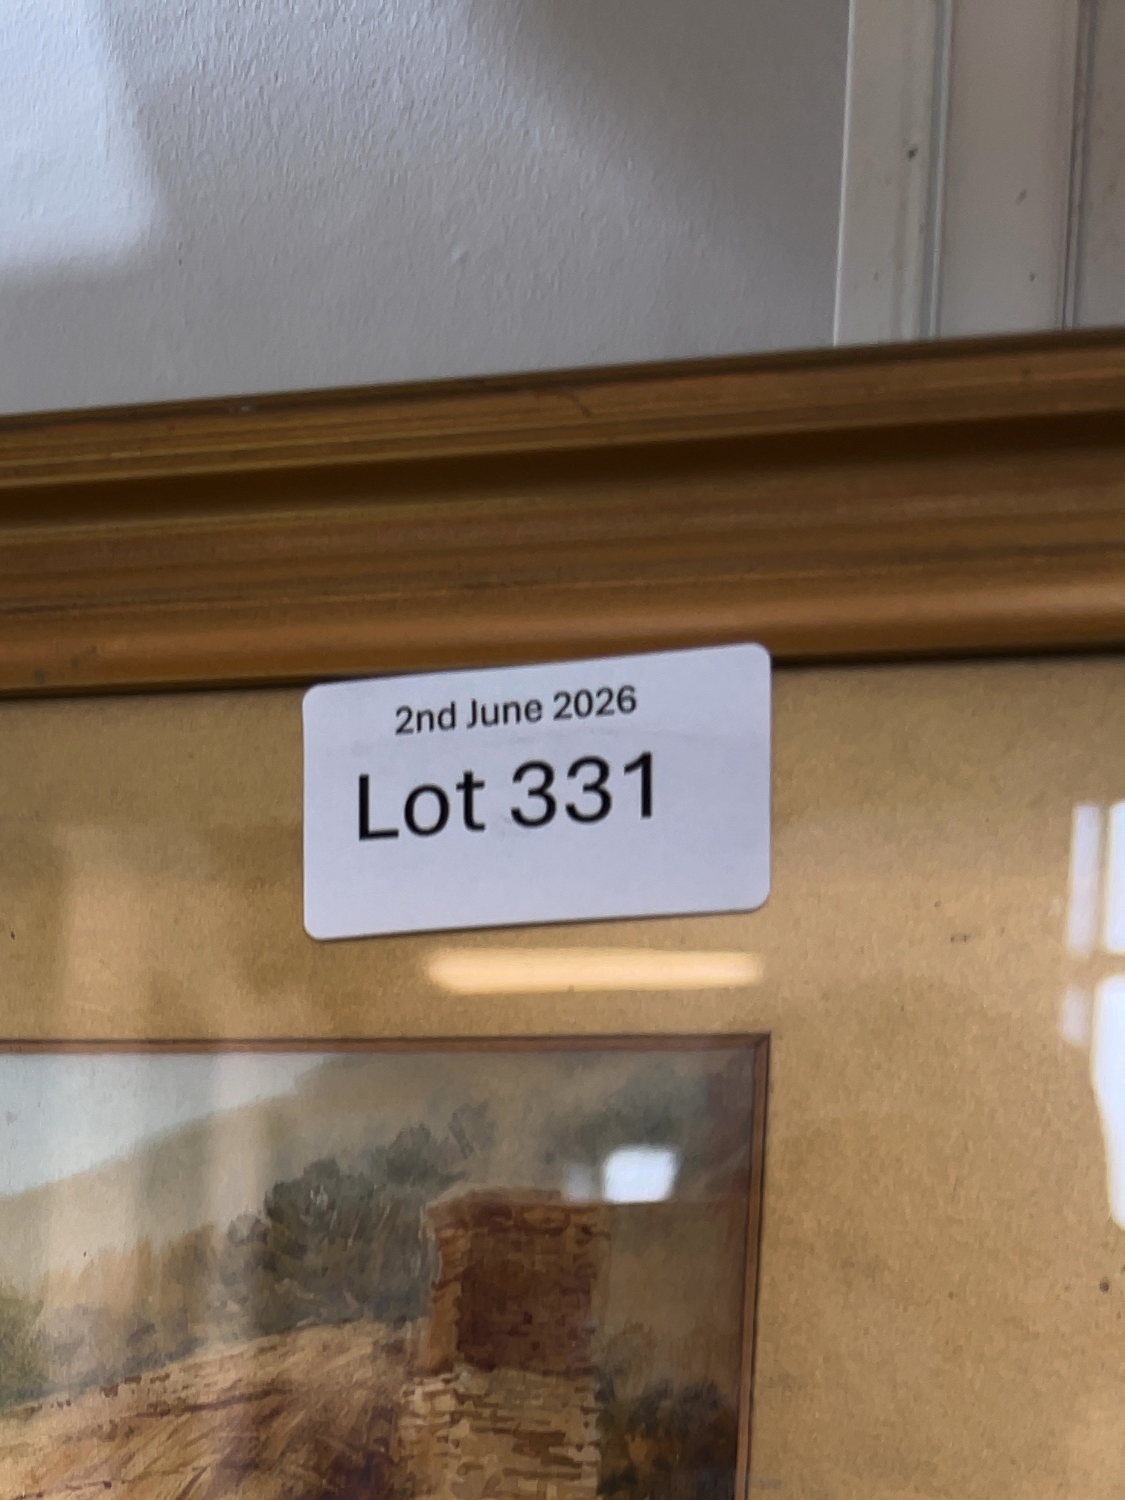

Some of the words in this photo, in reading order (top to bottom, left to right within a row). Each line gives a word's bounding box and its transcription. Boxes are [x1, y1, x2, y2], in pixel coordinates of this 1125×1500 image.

[395, 701, 457, 735] 2nd
[466, 697, 543, 730] June
[553, 685, 637, 721] 2026
[358, 769, 486, 841] Lot
[510, 751, 654, 829] 331
